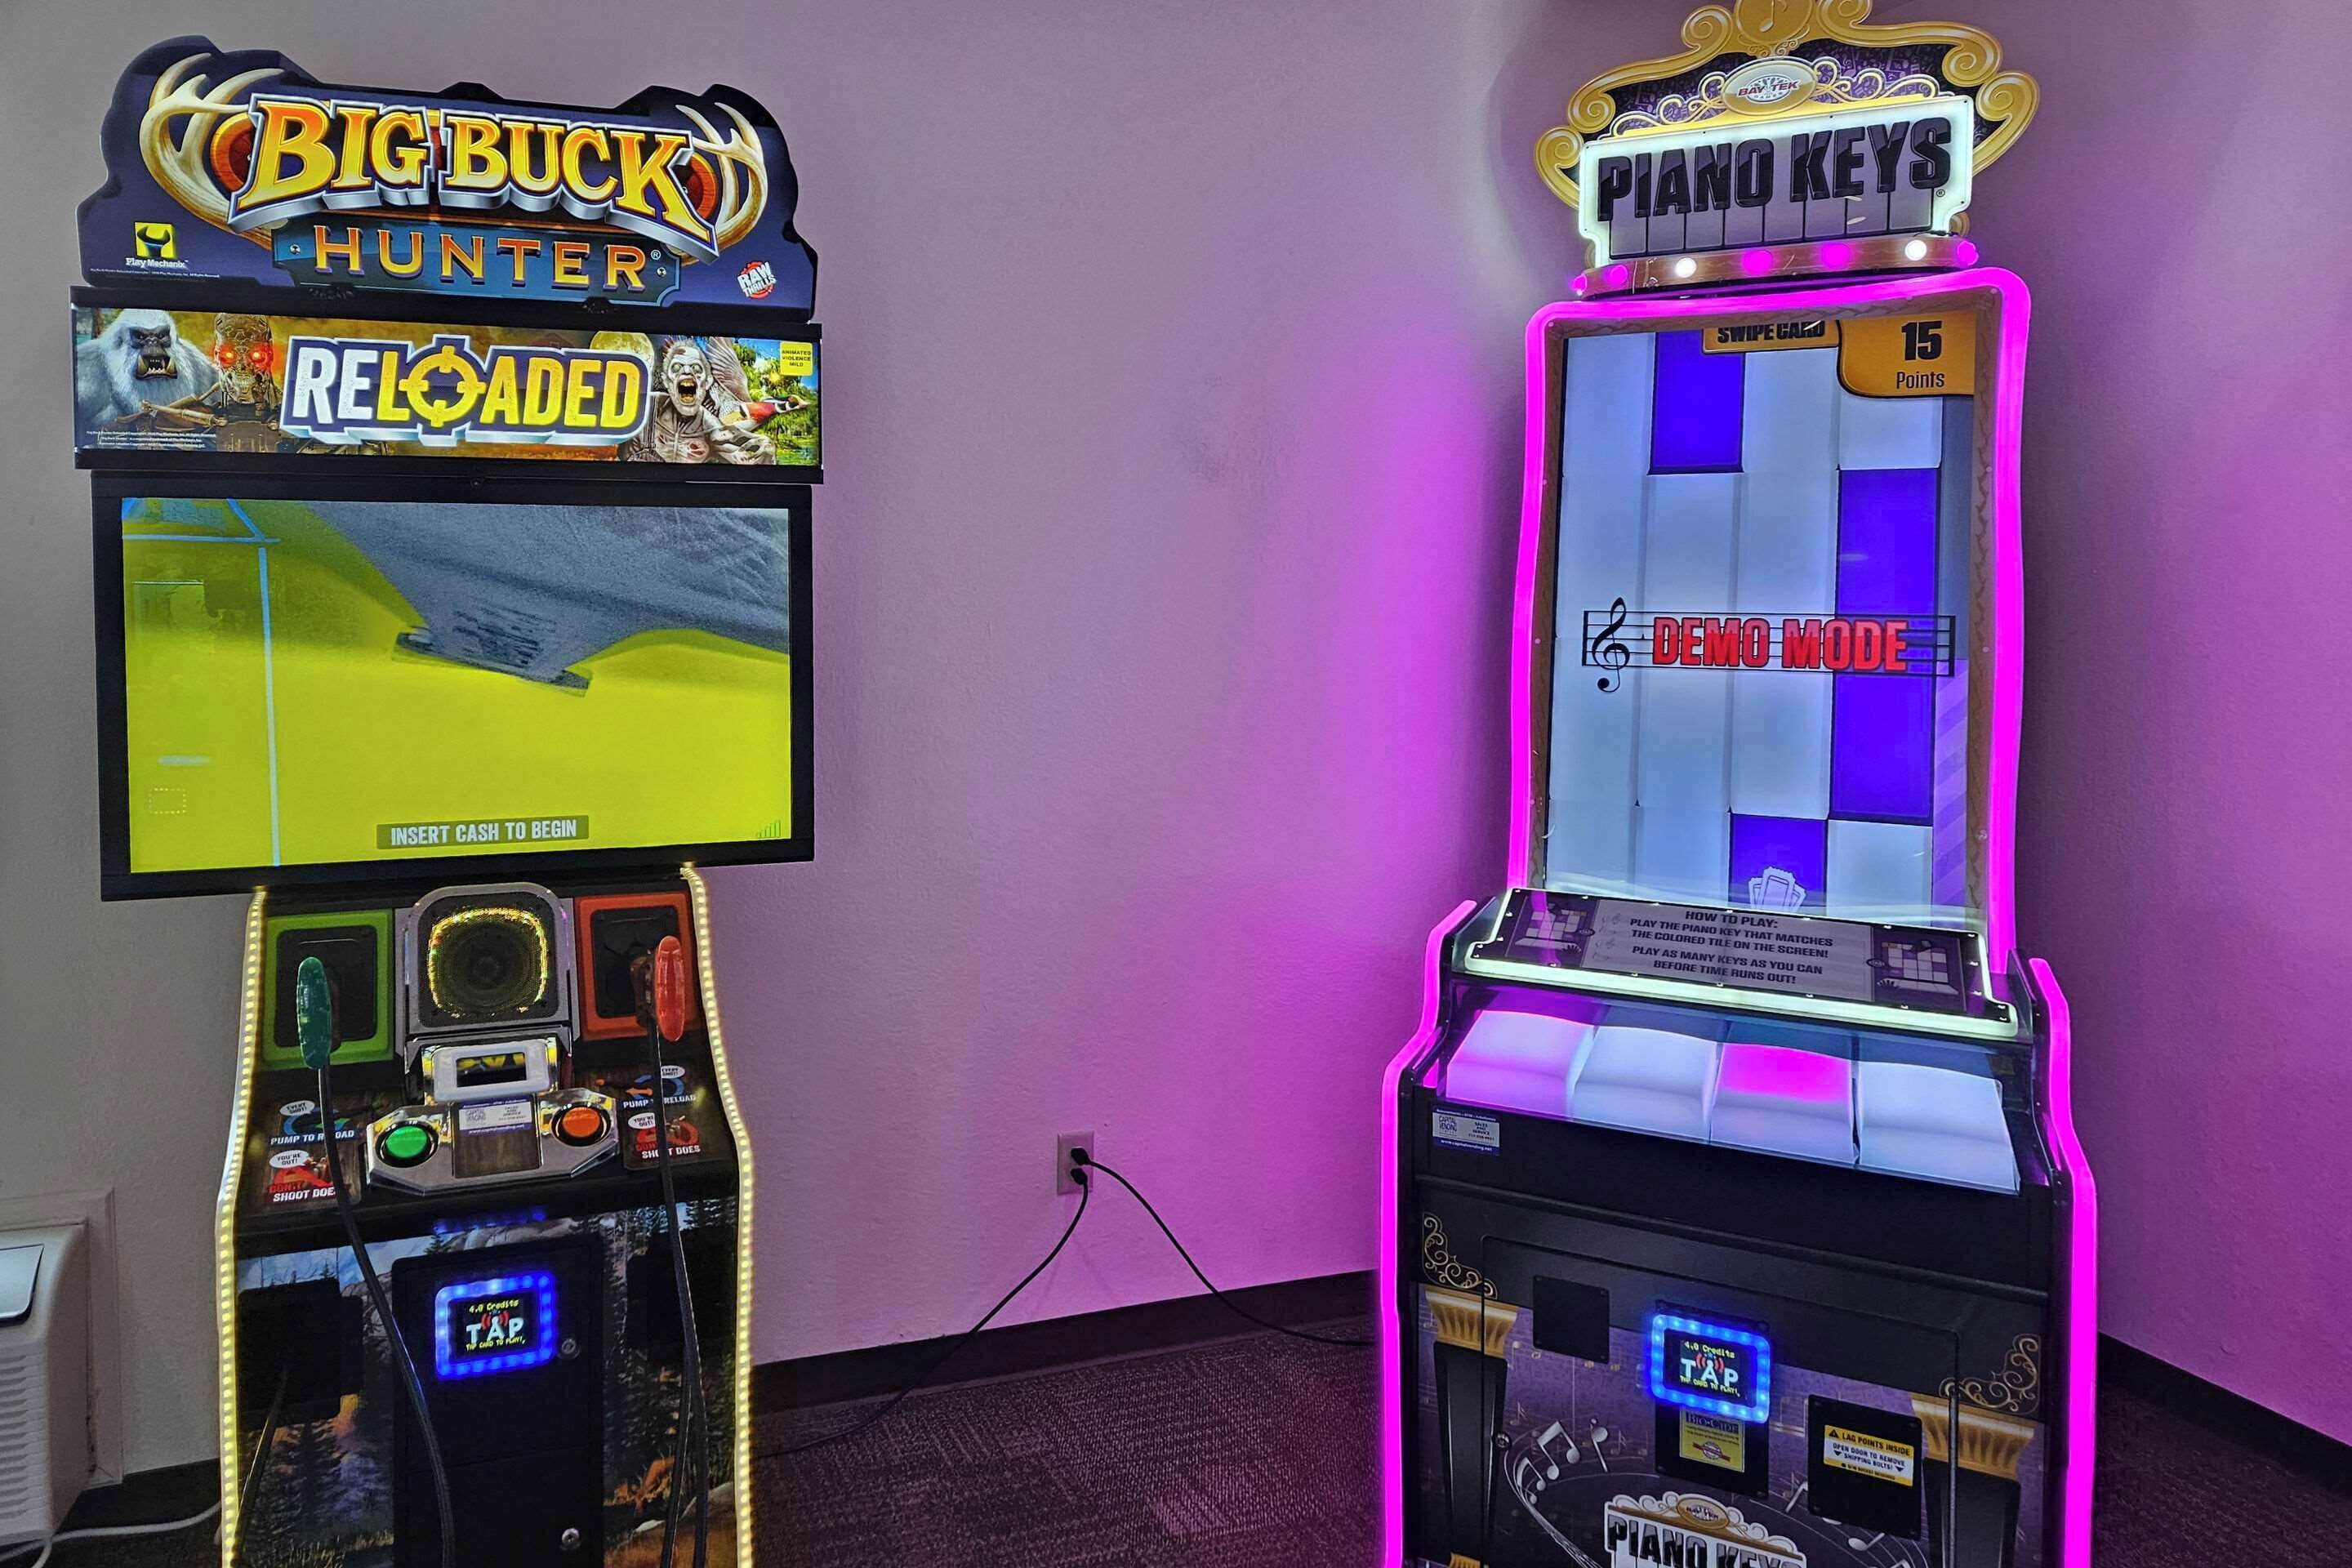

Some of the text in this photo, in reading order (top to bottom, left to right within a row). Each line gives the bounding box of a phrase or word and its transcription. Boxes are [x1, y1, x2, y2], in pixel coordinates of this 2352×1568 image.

[1738, 80, 1800, 96] BAY TEK
[235, 100, 714, 250] BIG BUCK
[1597, 138, 1774, 222] PIANO
[125, 257, 146, 268] Play
[737, 261, 773, 289] RAW
[742, 274, 777, 297] THRILLS
[1717, 320, 1825, 344] SWIPE CARD
[1900, 320, 1943, 361] 15
[292, 345, 641, 428] RELOADED
[1895, 370, 1945, 390] Points
[1652, 617, 1909, 672] DEMO MODE
[391, 818, 577, 846] INSERT CASH TO BEGIN
[1685, 911, 1778, 929] HOW TO PLAY:
[1630, 919, 1833, 947] PLAY THE PIANO KEY THAT MATCHES
[1632, 929, 1829, 958] THE COLORED TILE ON THE SCREEN!
[1632, 946, 1823, 974] PLAY AS MANY KEYS AS YOU CAN
[1654, 960, 1797, 984] BEFORE TIME RUNS OUT!
[623, 1100, 648, 1108] PUMP
[663, 1094, 697, 1104] RELOAD
[270, 1130, 354, 1145] PUMP TO ROAD
[277, 1152, 301, 1160] YOU'RE
[676, 1145, 701, 1155] DOES
[273, 1187, 336, 1202] SHOOT DOE
[486, 1299, 519, 1310] Credits
[466, 1316, 524, 1346] TAP
[1684, 1341, 1735, 1359] 4.0 Credits
[1681, 1357, 1739, 1389] TAP
[1833, 1442, 1850, 1452] OPEN
[1851, 1447, 1868, 1457] DOOR
[1879, 1454, 1905, 1467] REMOVE
[1842, 1432, 1909, 1455] LAG POINTS INSIDE
[1844, 1453, 1893, 1470] SHIPPING BOLTS!
[1607, 1514, 1708, 1568] PIANO
